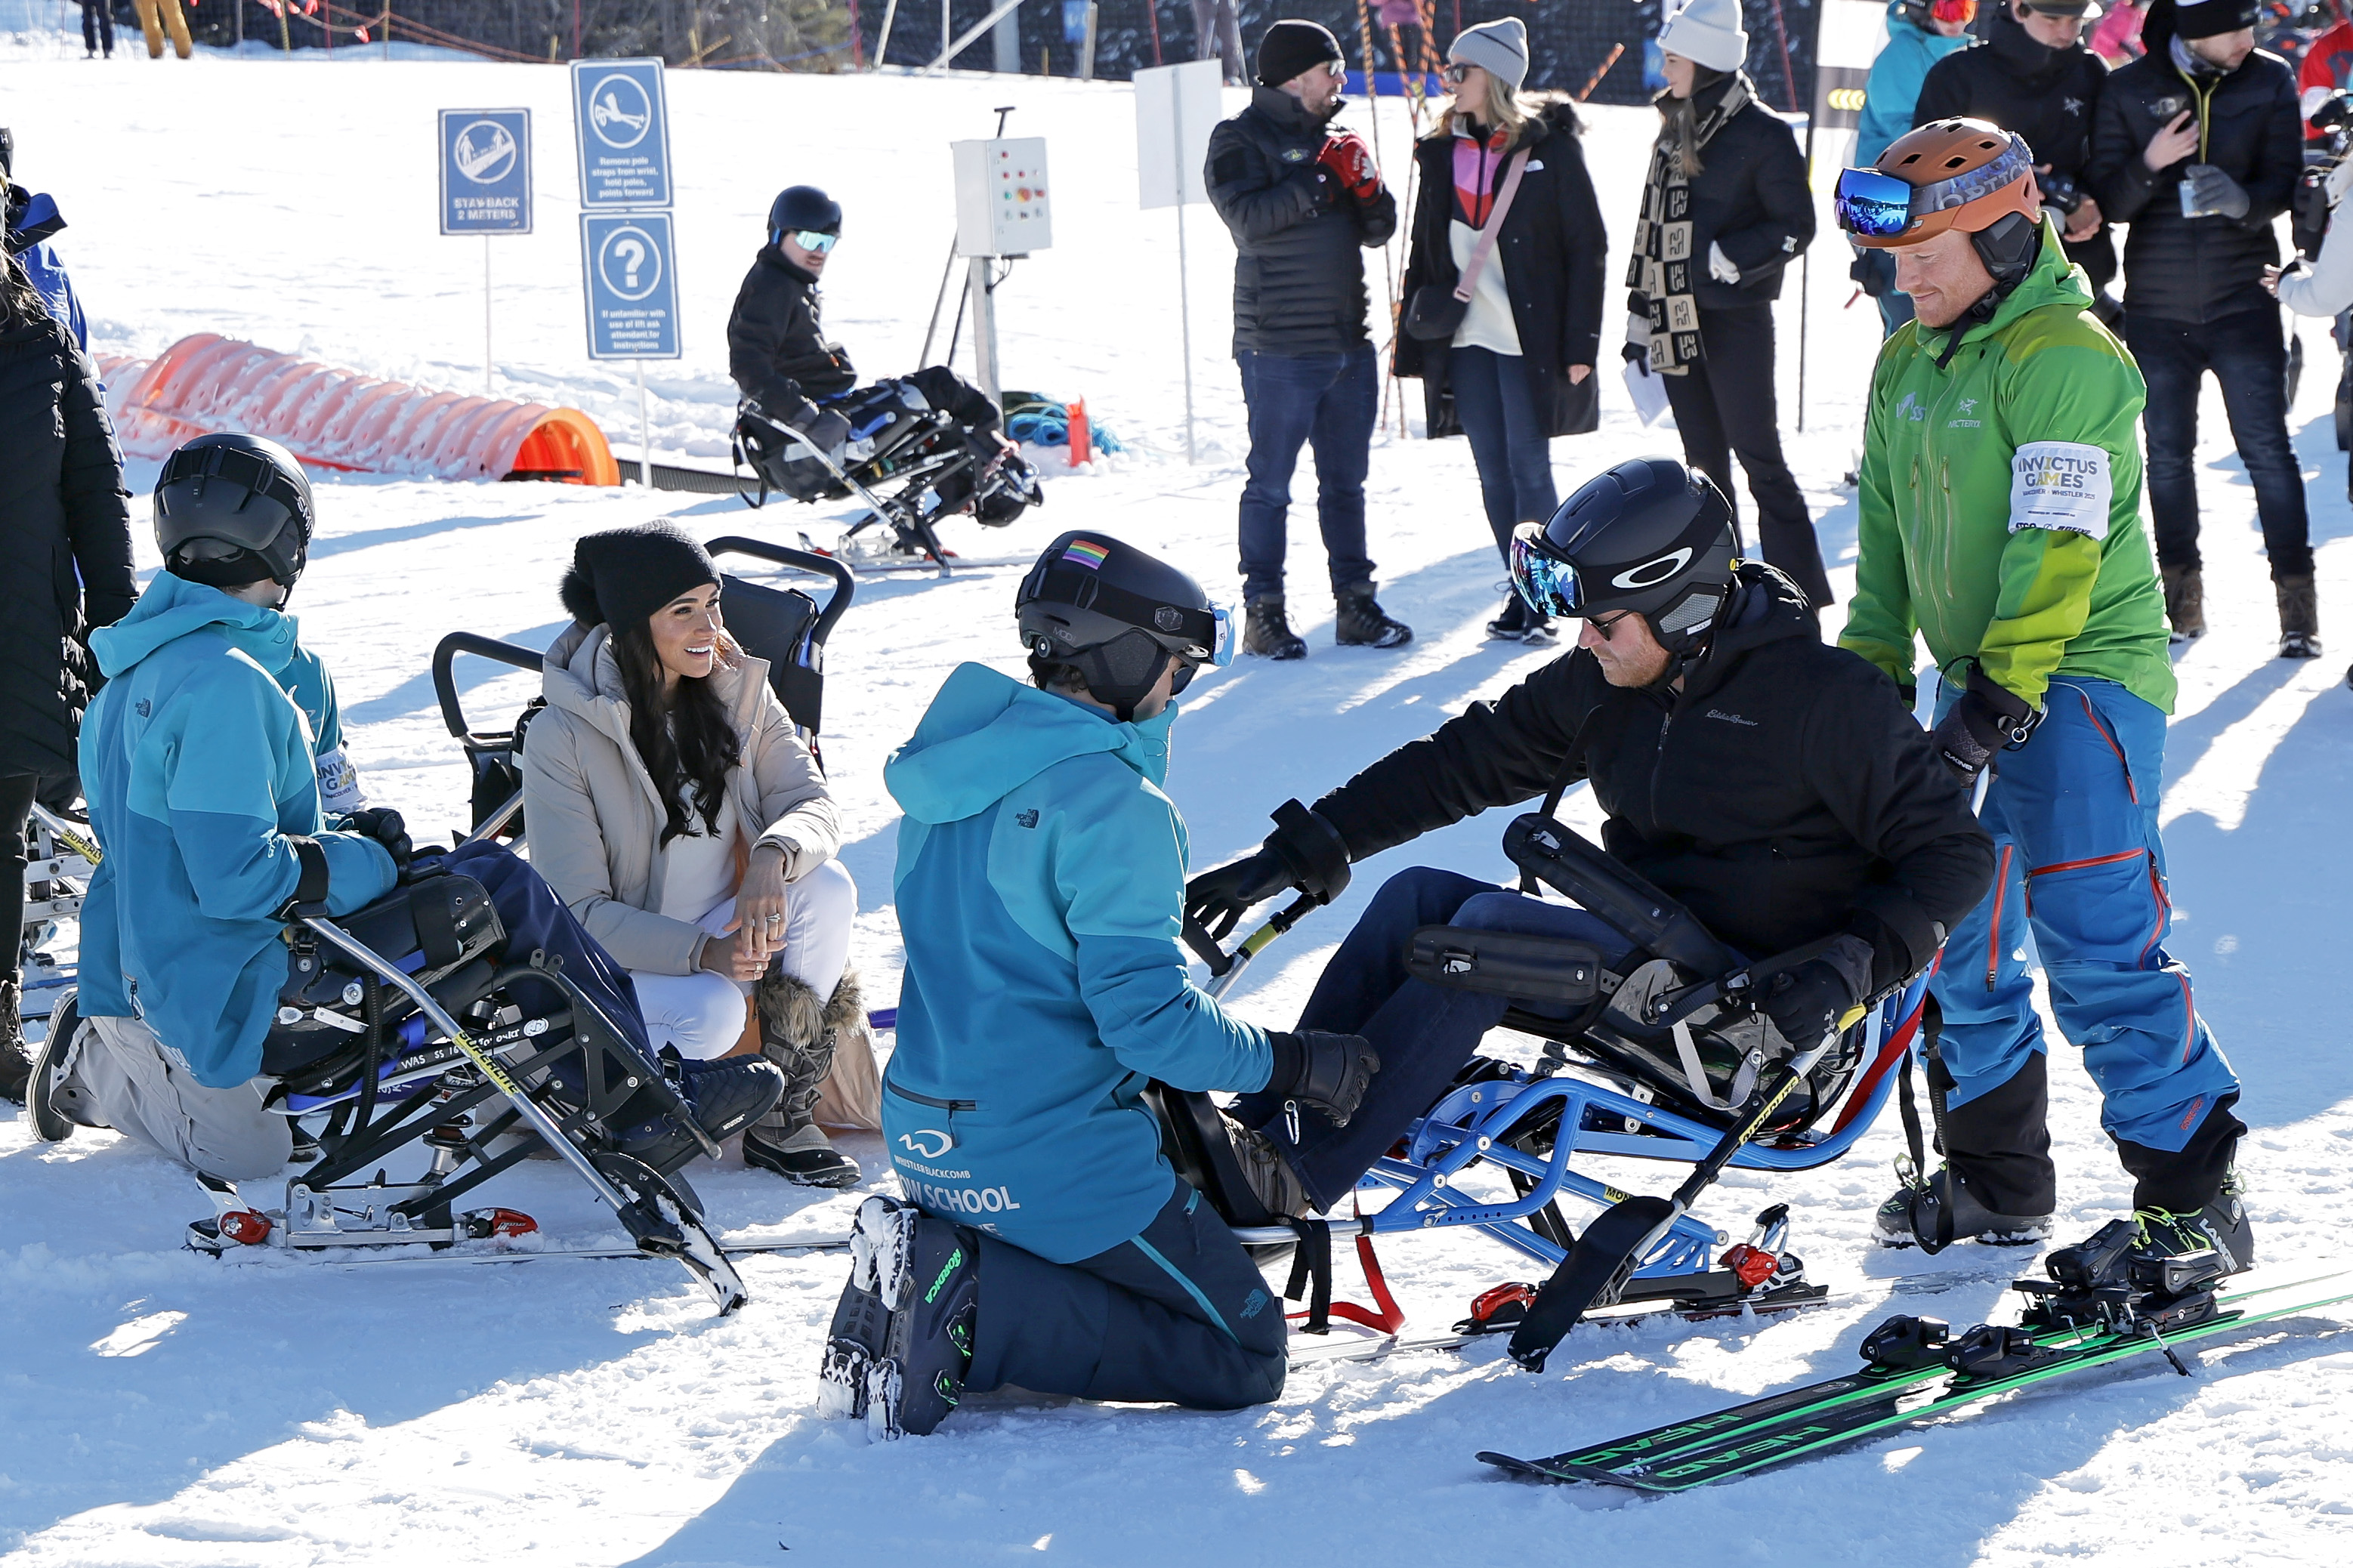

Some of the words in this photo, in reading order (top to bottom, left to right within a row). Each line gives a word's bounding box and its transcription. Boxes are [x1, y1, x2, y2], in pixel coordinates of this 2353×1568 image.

[600, 157, 630, 165] Remove
[631, 156, 649, 167] pole
[592, 168, 616, 177] straps
[599, 188, 622, 198] points
[625, 187, 654, 196] forward
[455, 198, 486, 208] STAY
[486, 198, 519, 208] BACK
[458, 211, 465, 221] 2
[468, 209, 516, 220] METERS
[610, 310, 648, 318] unfamiliar
[650, 309, 665, 317] with
[625, 320, 633, 329] of
[611, 331, 648, 339] attendant
[2018, 455, 2098, 475] INVICTUS
[2025, 471, 2085, 489] GAMES
[2051, 489, 2083, 498] WHISTLER
[1944, 751, 1973, 771] DAKINE
[401, 1054, 426, 1069] WAS
[434, 1047, 444, 1059] SS
[459, 1032, 519, 1094] SUPERLITE
[894, 1154, 925, 1173] WHISTLER
[925, 1167, 971, 1179] BLACKCOMB
[923, 1184, 1021, 1214] SCHOOL
[2199, 1218, 2238, 1273] LANGE
[925, 1248, 961, 1304] NORDICA
[1567, 1414, 1743, 1466] HEAD
[1655, 1426, 1830, 1478] HEAD
